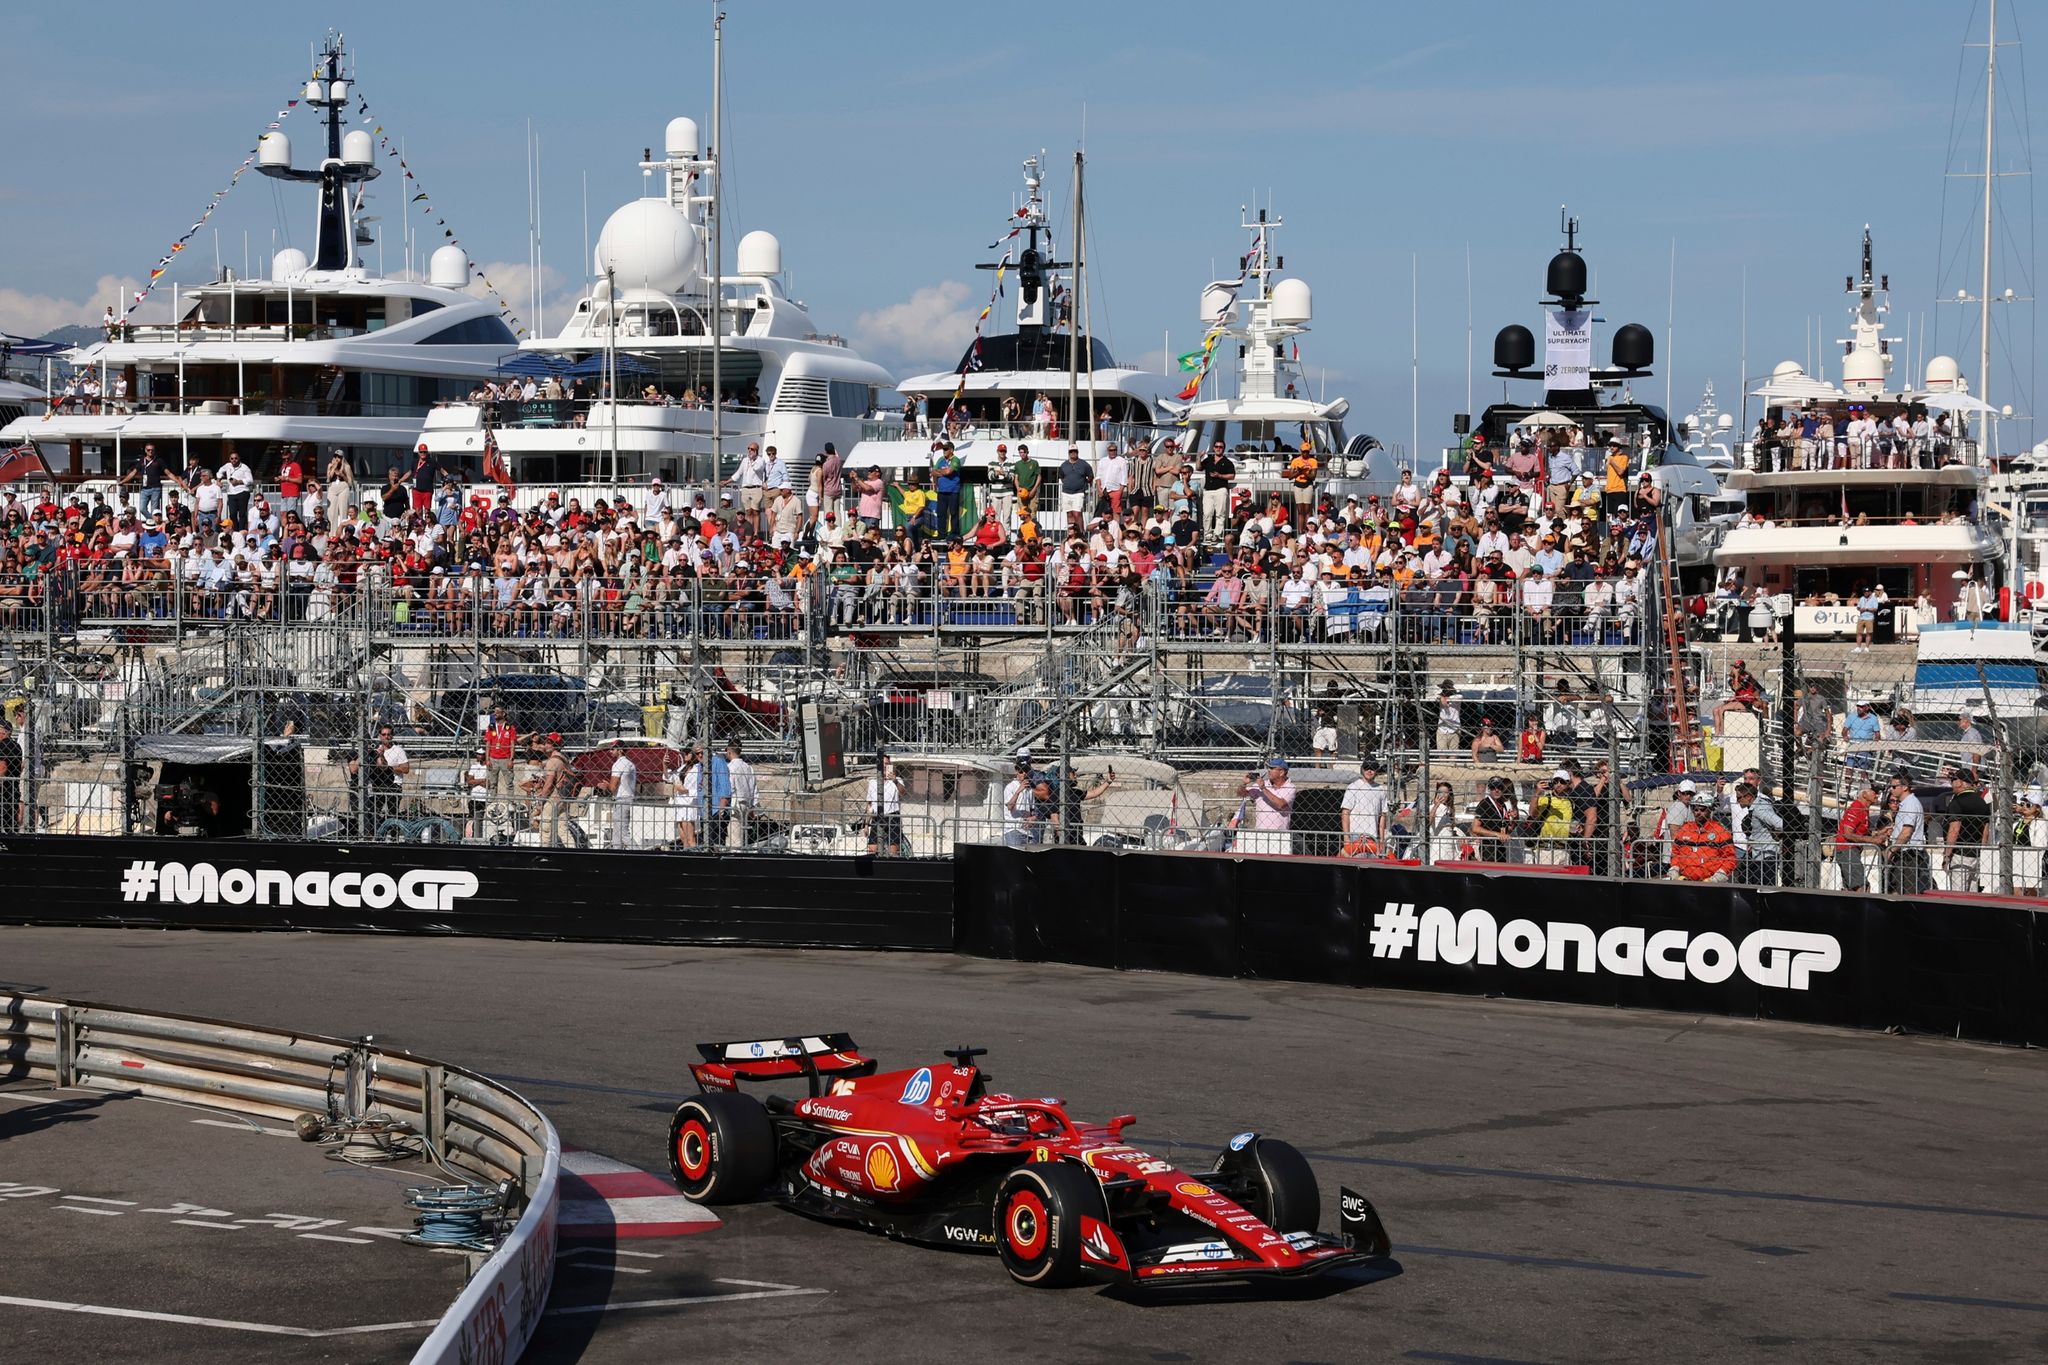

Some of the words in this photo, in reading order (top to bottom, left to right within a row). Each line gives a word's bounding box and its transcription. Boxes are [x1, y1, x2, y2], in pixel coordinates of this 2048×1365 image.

[120, 860, 479, 911] #MonacoGP
[1369, 902, 1842, 990] #MonacoGP
[751, 1043, 764, 1057] hp
[903, 1071, 930, 1104] hp
[811, 1102, 853, 1121] Santander
[839, 1167, 862, 1181] PERONI
[1342, 1195, 1365, 1212] aws
[944, 1225, 979, 1242] VGW
[979, 1234, 996, 1243] PLA
[1165, 1265, 1220, 1274] V-Power
